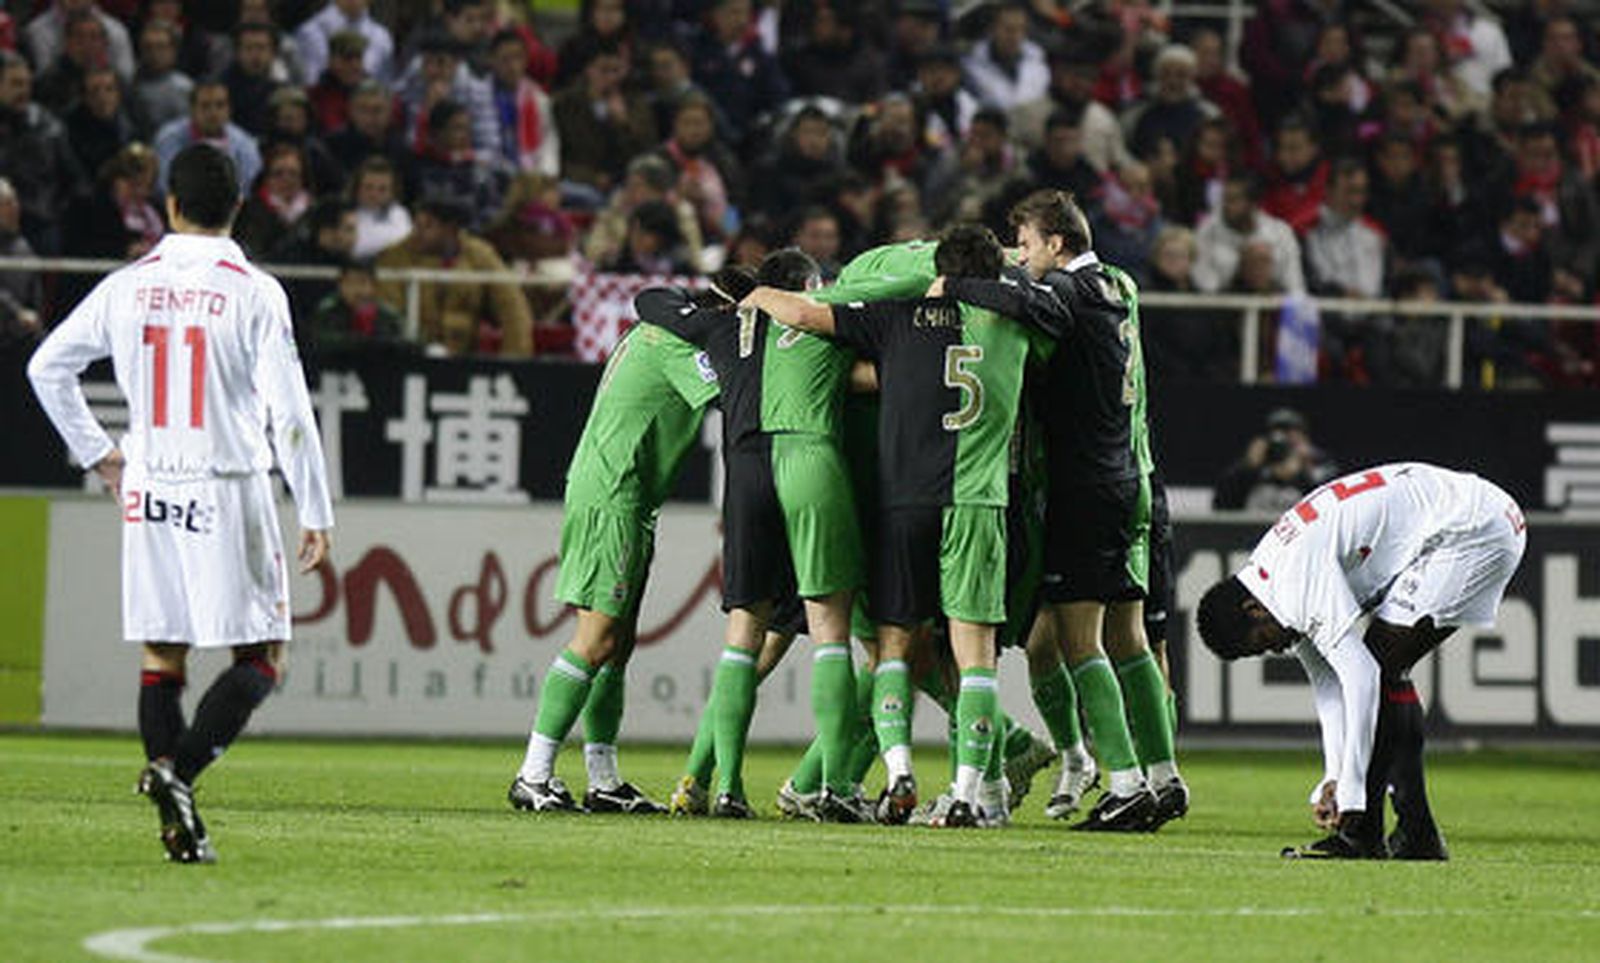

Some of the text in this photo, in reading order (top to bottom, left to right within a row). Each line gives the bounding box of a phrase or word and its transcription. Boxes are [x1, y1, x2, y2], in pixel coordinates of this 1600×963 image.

[137, 288, 226, 316] RENATO
[142, 324, 208, 430] 11
[942, 344, 984, 431] 5
